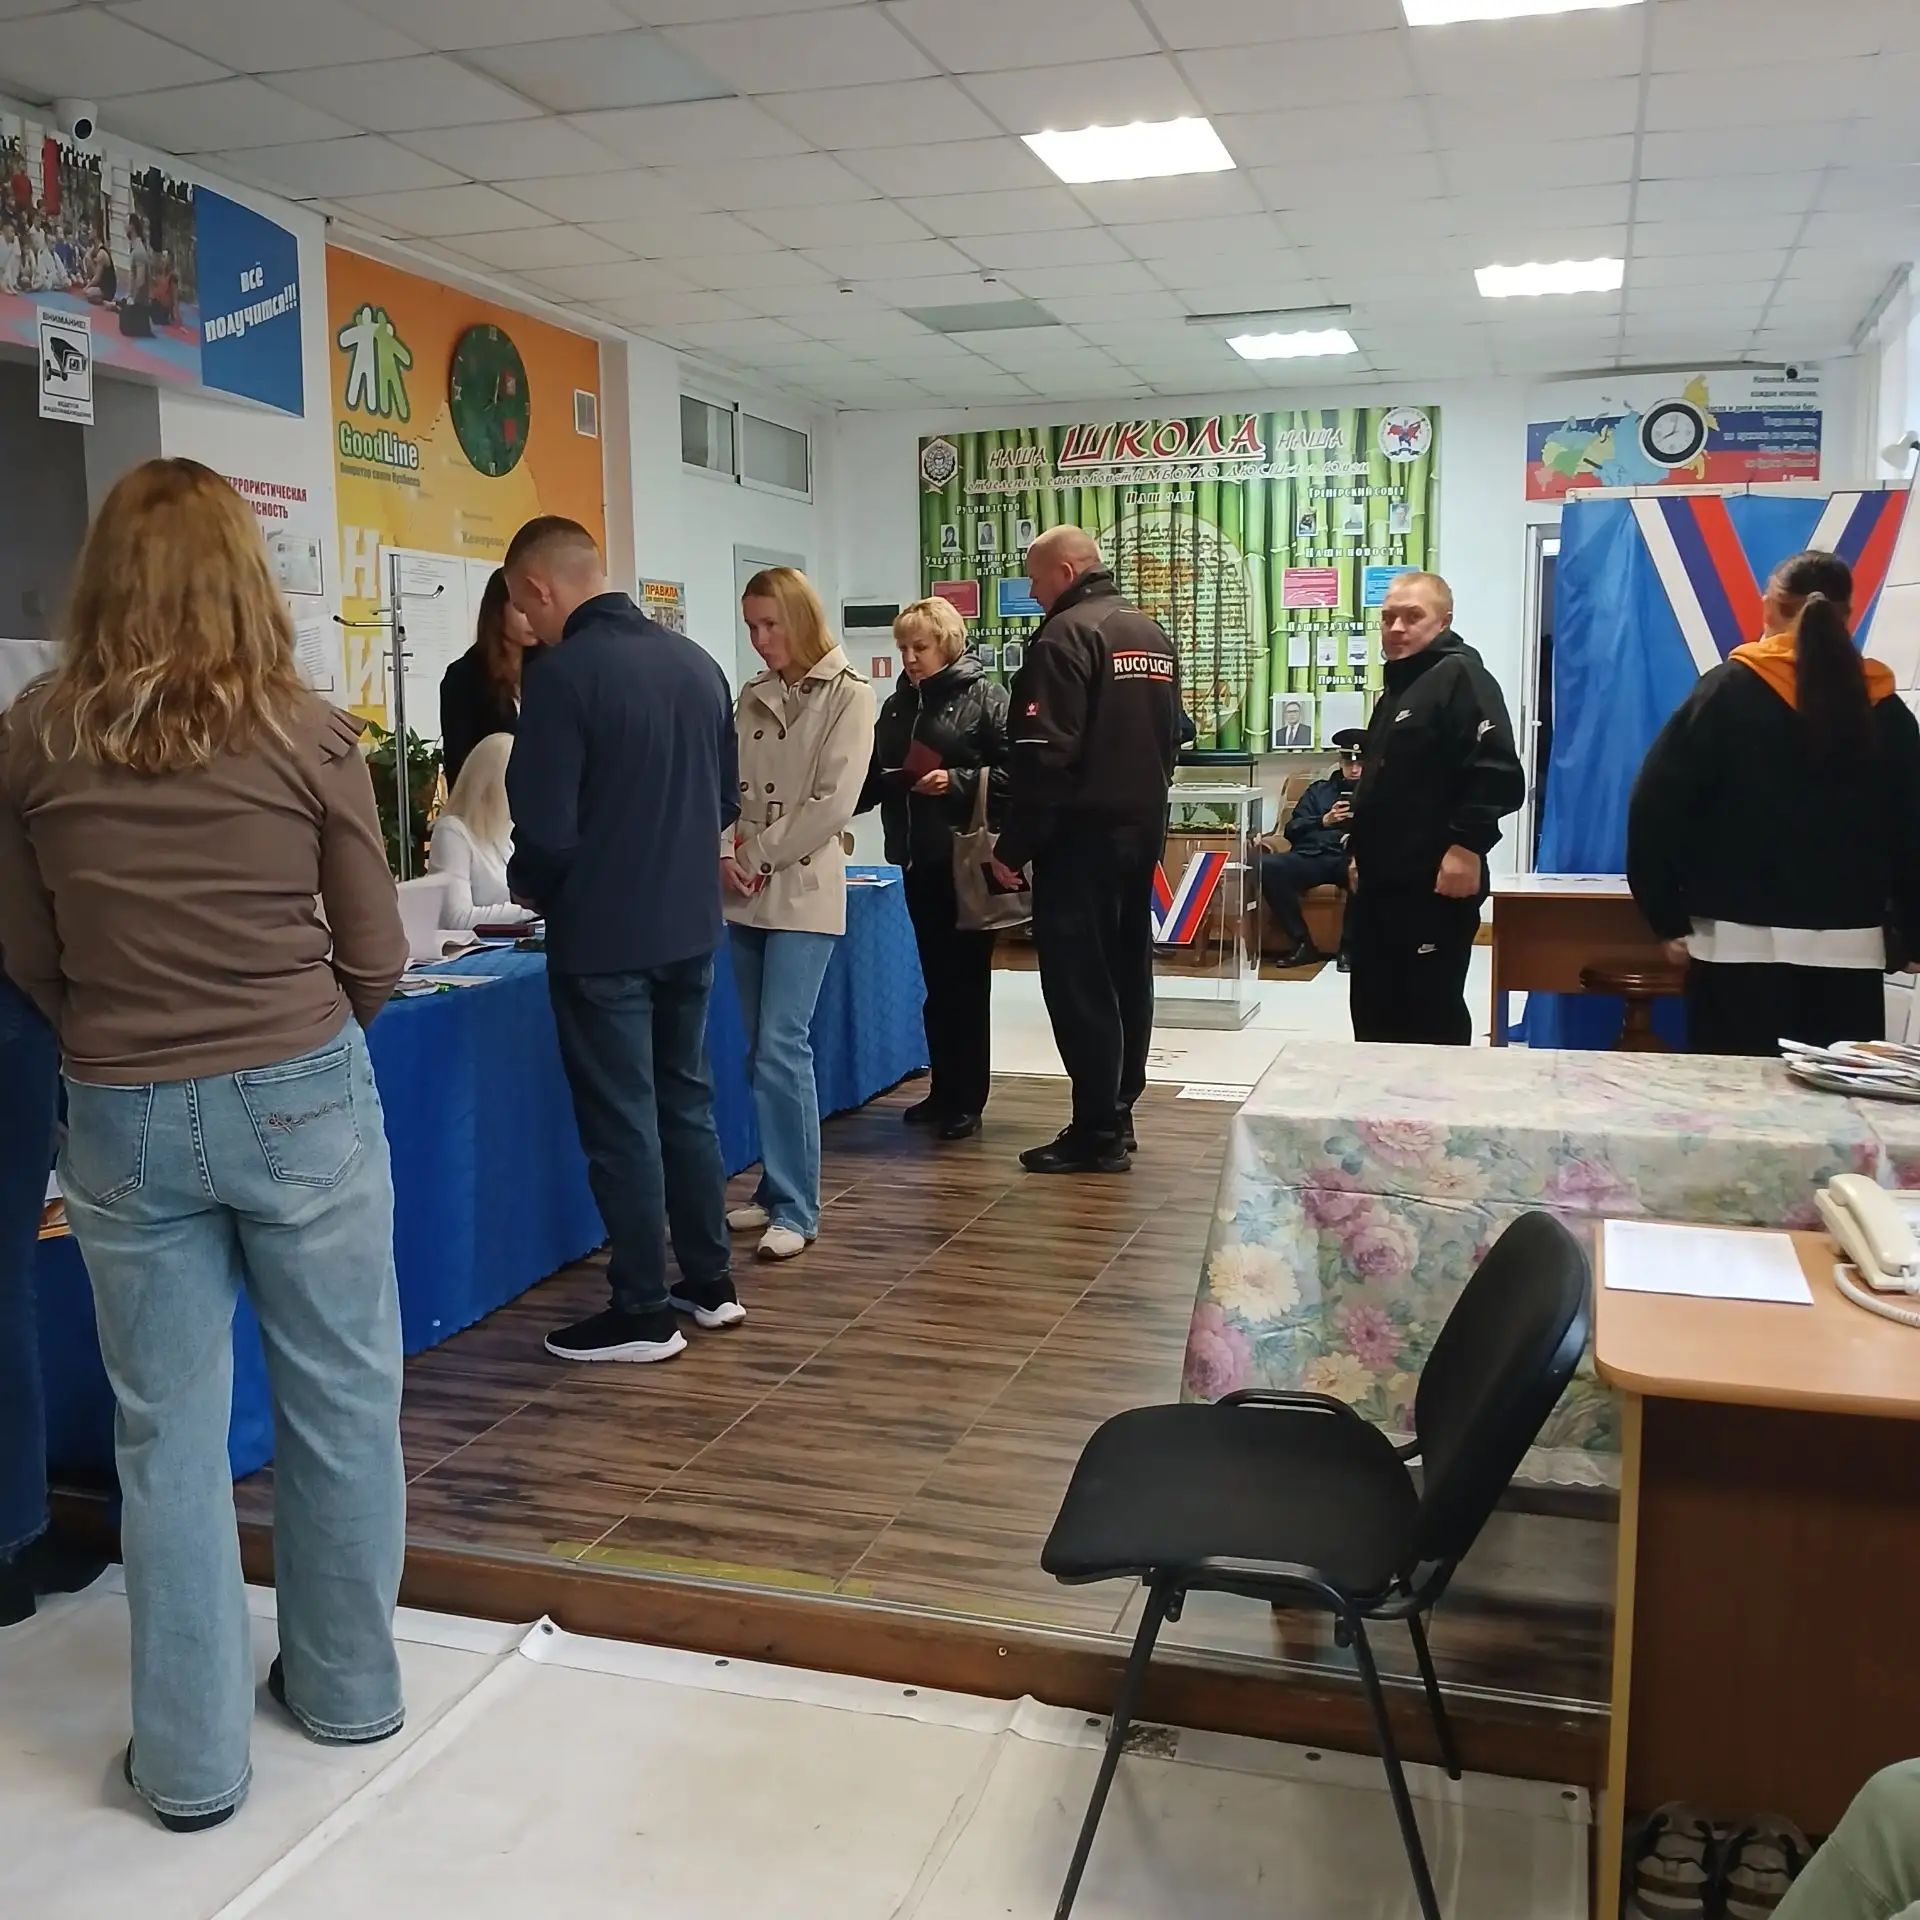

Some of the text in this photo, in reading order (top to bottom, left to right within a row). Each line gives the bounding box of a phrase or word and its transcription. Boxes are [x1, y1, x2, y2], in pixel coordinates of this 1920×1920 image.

[204, 283, 298, 343] получится!!!
[339, 421, 420, 471] GoodLine
[988, 414, 1344, 469] НАША ШКОЛА НАША
[228, 477, 307, 502] РРОРИСТИЧЕСКАЯ
[1126, 491, 1160, 504] НАШ
[250, 500, 289, 519] АСНОСТЬ
[925, 552, 1028, 566] УЧЕБНО-ТРЕНИРОВО
[645, 584, 679, 598] ПРАВИЛА
[1113, 656, 1148, 674] RUCO
